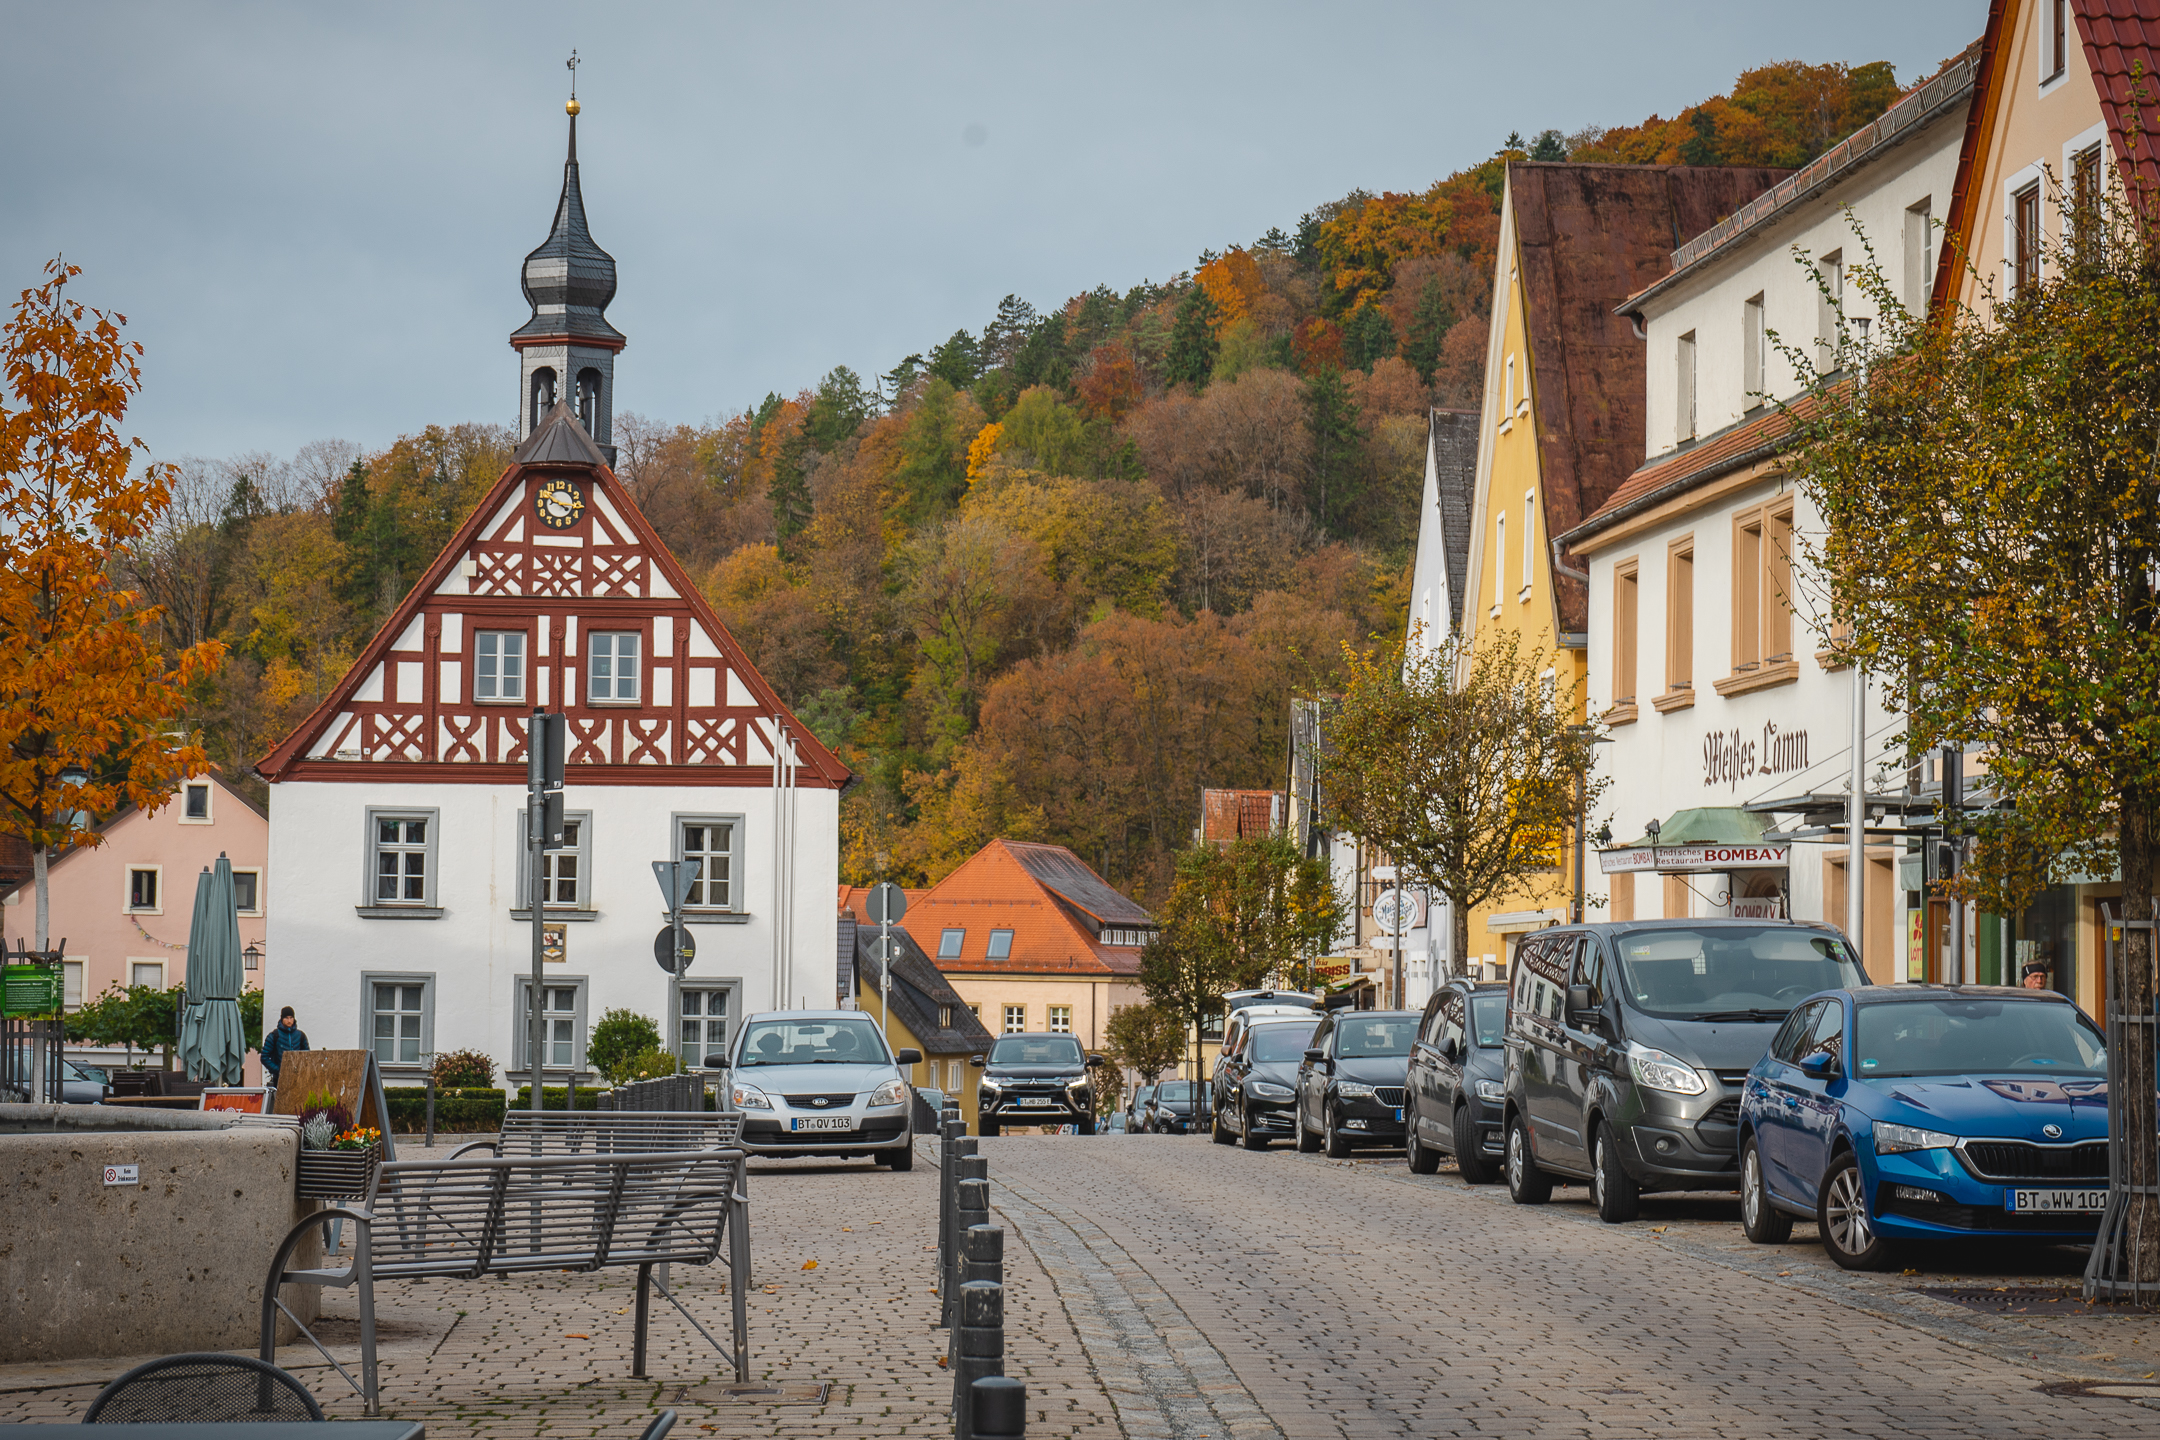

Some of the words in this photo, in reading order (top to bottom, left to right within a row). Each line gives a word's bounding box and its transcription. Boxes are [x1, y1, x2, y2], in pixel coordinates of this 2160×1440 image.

[547, 483, 555, 491] 11
[556, 481, 565, 490] 12
[567, 484, 572, 492] 1
[573, 491, 579, 500] 2
[537, 499, 544, 508] 9
[540, 509, 546, 517] 8
[573, 510, 579, 518] 4
[546, 516, 552, 525] 7
[556, 519, 562, 527] 6
[565, 517, 571, 525] 5
[1703, 727, 1755, 794] Weißes
[1758, 718, 1809, 776] Lamm
[1633, 851, 1653, 865] BOMBAY
[1704, 848, 1786, 862] BOMBAY
[1656, 857, 1703, 865] Restaurant
[1911, 947, 1922, 961] LOTT
[798, 1119, 811, 1129] BT
[816, 1119, 830, 1129] QV
[832, 1118, 850, 1129] 103
[2017, 1191, 2039, 1209] BT
[2052, 1191, 2074, 1209] WW
[2078, 1191, 2108, 1209] 101
